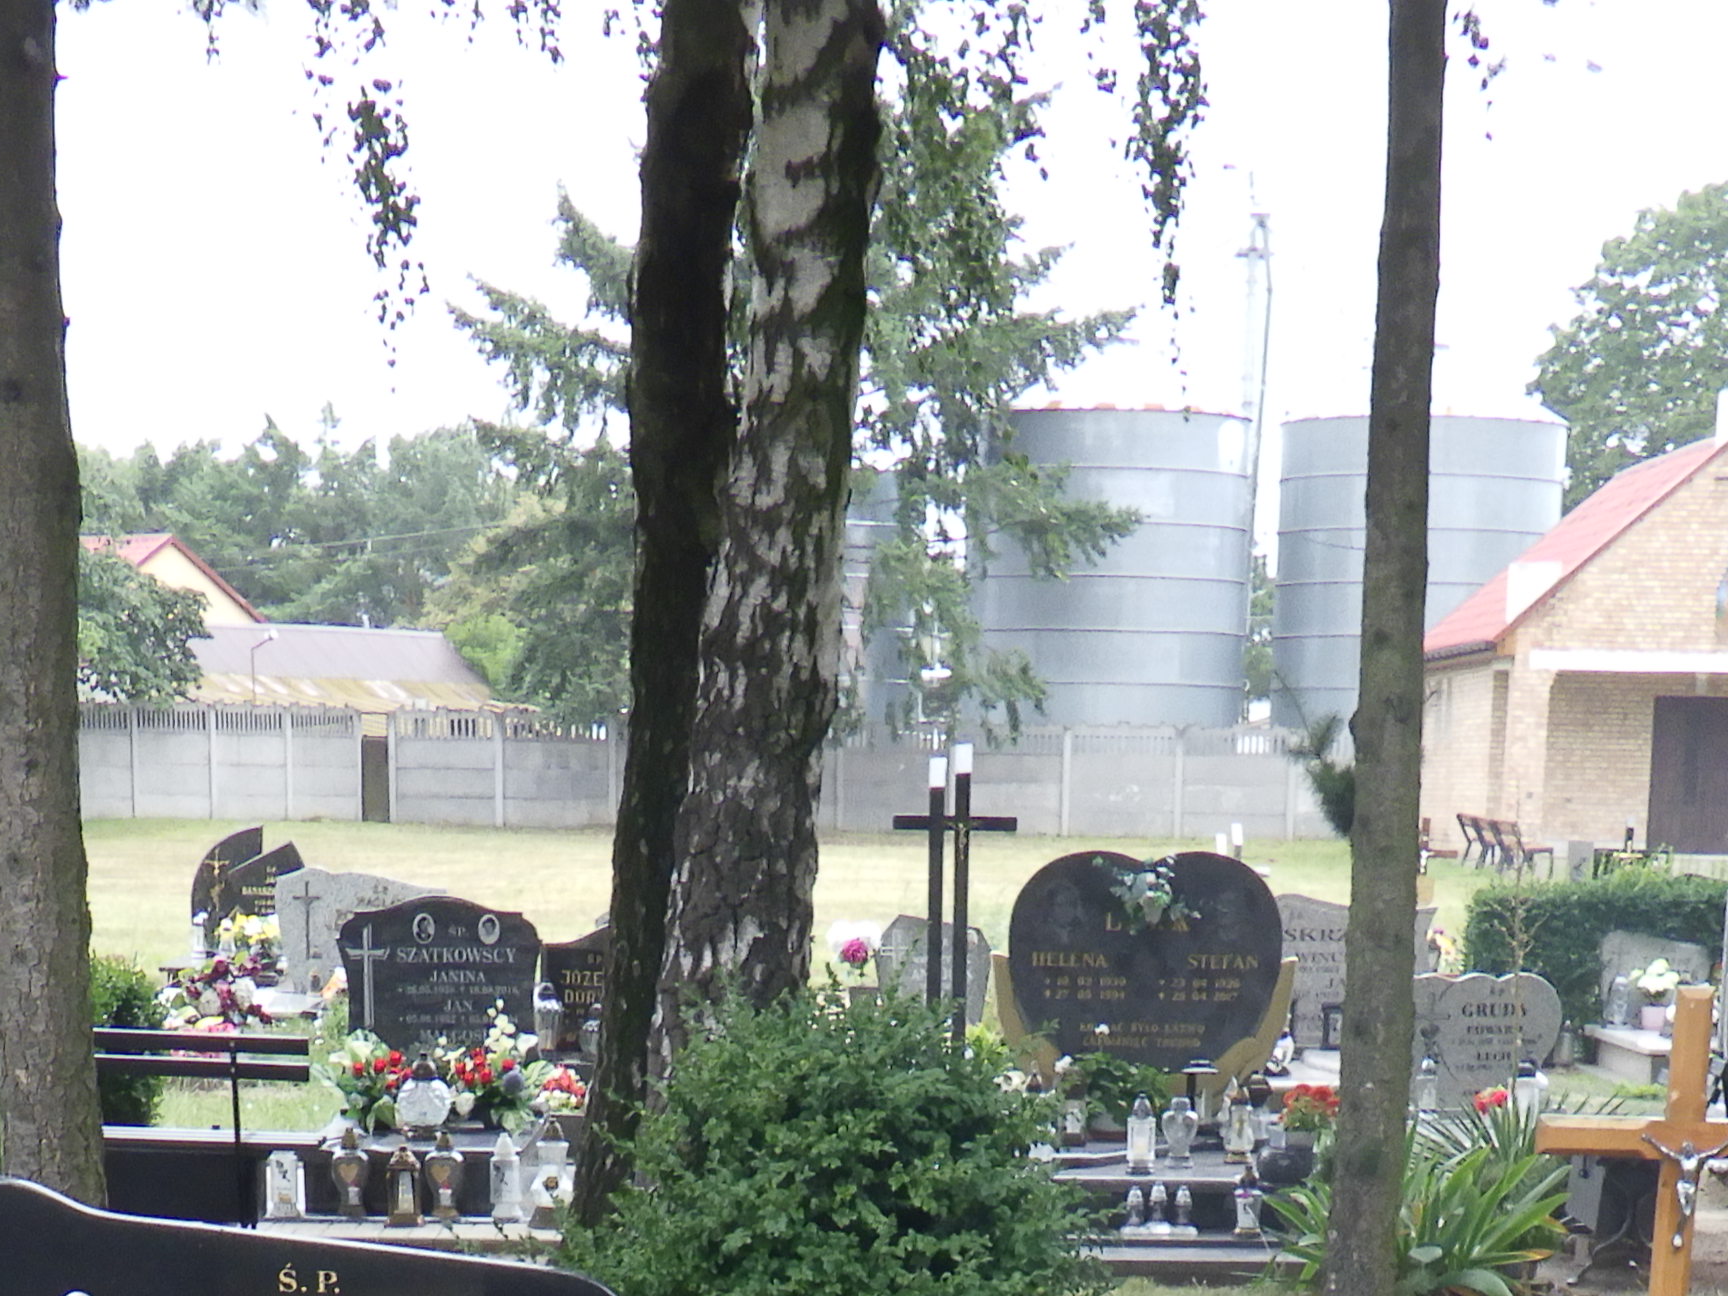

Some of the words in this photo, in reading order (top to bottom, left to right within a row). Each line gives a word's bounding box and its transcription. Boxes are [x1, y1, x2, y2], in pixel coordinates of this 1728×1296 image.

[395, 947, 517, 964] SZATKOWSCY
[1032, 951, 1109, 968] HELENA
[1186, 953, 1259, 970] STEFAN
[429, 969, 487, 984] JANINA
[443, 999, 472, 1012] JAN
